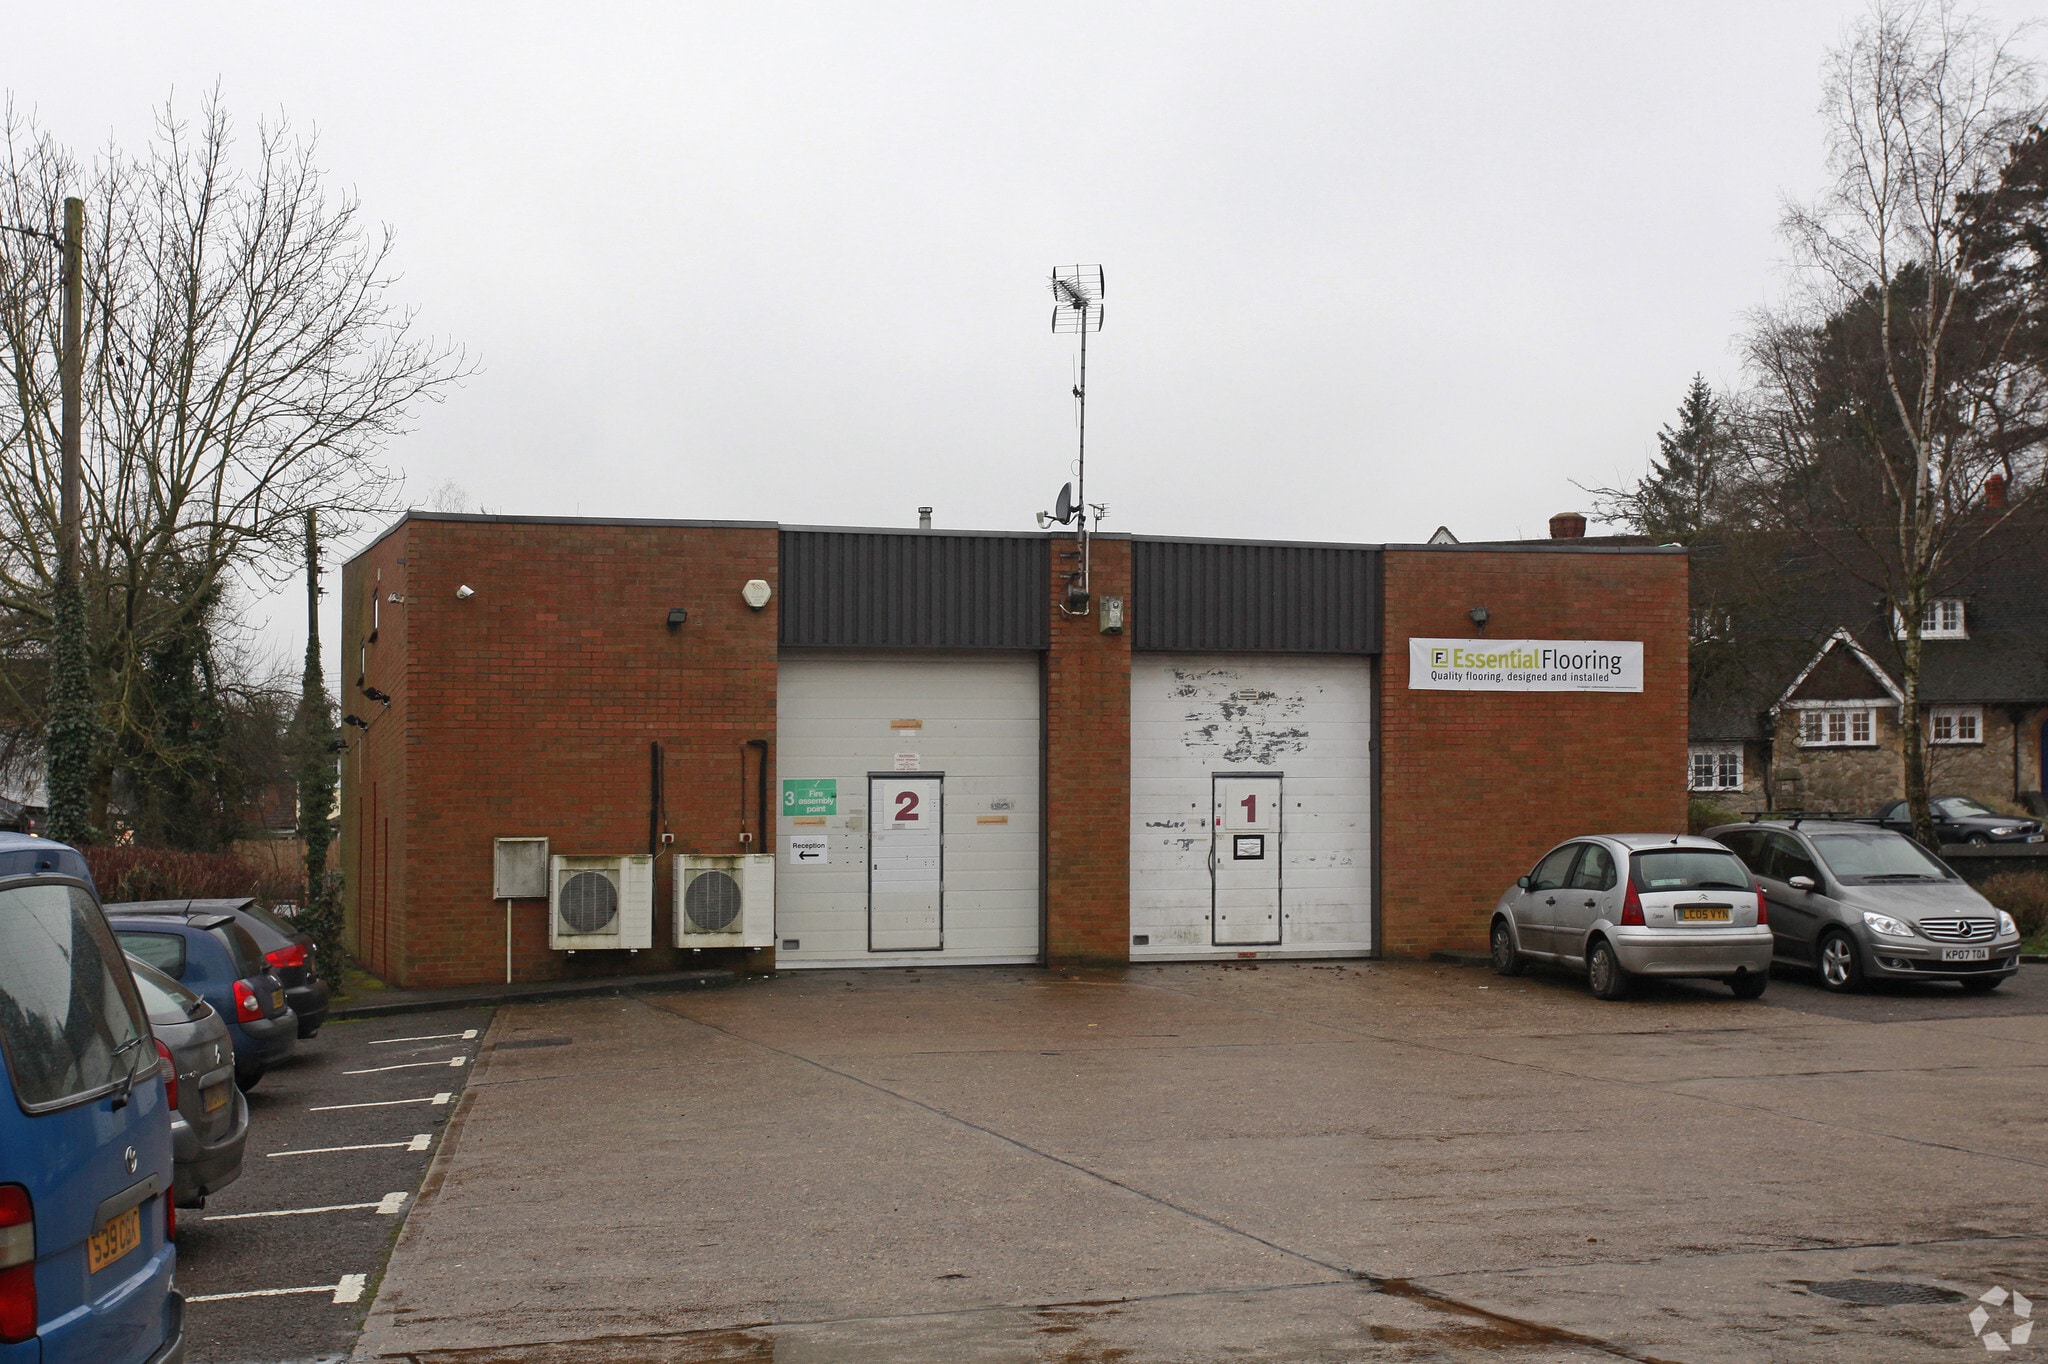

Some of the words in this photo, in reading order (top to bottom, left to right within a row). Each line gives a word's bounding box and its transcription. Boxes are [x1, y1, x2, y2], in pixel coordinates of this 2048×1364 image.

[1435, 652, 1443, 664] F
[1431, 670, 1462, 682] Quality
[1466, 671, 1504, 683] flooring,
[1507, 672, 1547, 683] designed
[1551, 673, 1567, 681] and
[1570, 673, 1609, 682] installed
[785, 791, 795, 806] 3
[798, 797, 834, 805] assembly
[806, 805, 826, 813] point
[894, 791, 919, 821] 2
[1241, 795, 1256, 823] 1
[792, 842, 825, 850] Reception
[1683, 909, 1708, 920] LC05
[1709, 909, 1729, 920] VYN
[1945, 950, 1970, 960] KP07
[1972, 949, 1986, 959] TOA
[92, 1224, 118, 1263] S39
